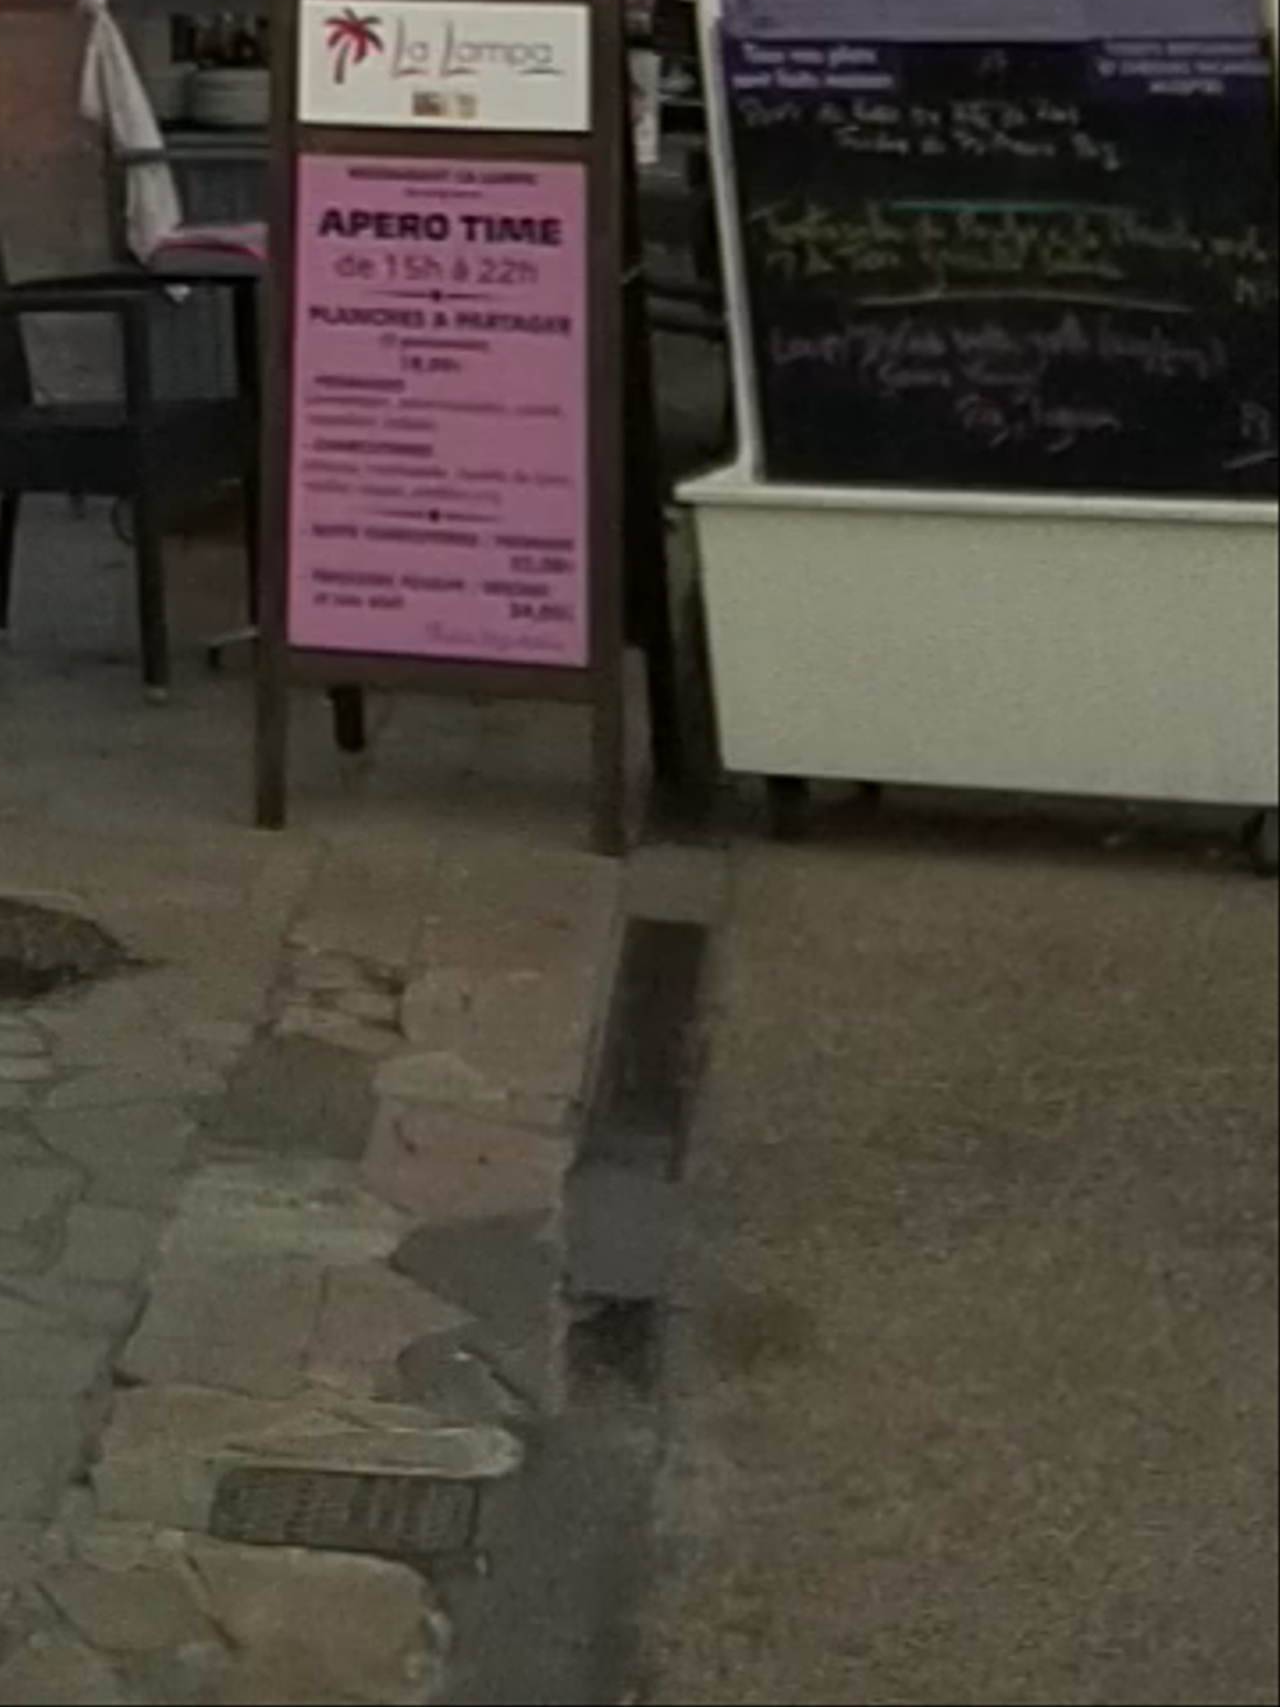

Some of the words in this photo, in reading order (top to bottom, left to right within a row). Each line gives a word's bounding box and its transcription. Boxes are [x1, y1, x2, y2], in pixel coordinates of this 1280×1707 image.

[391, 18, 430, 79] La
[439, 20, 564, 78] Lampa
[316, 208, 450, 241] APERO
[459, 214, 563, 247] TIME
